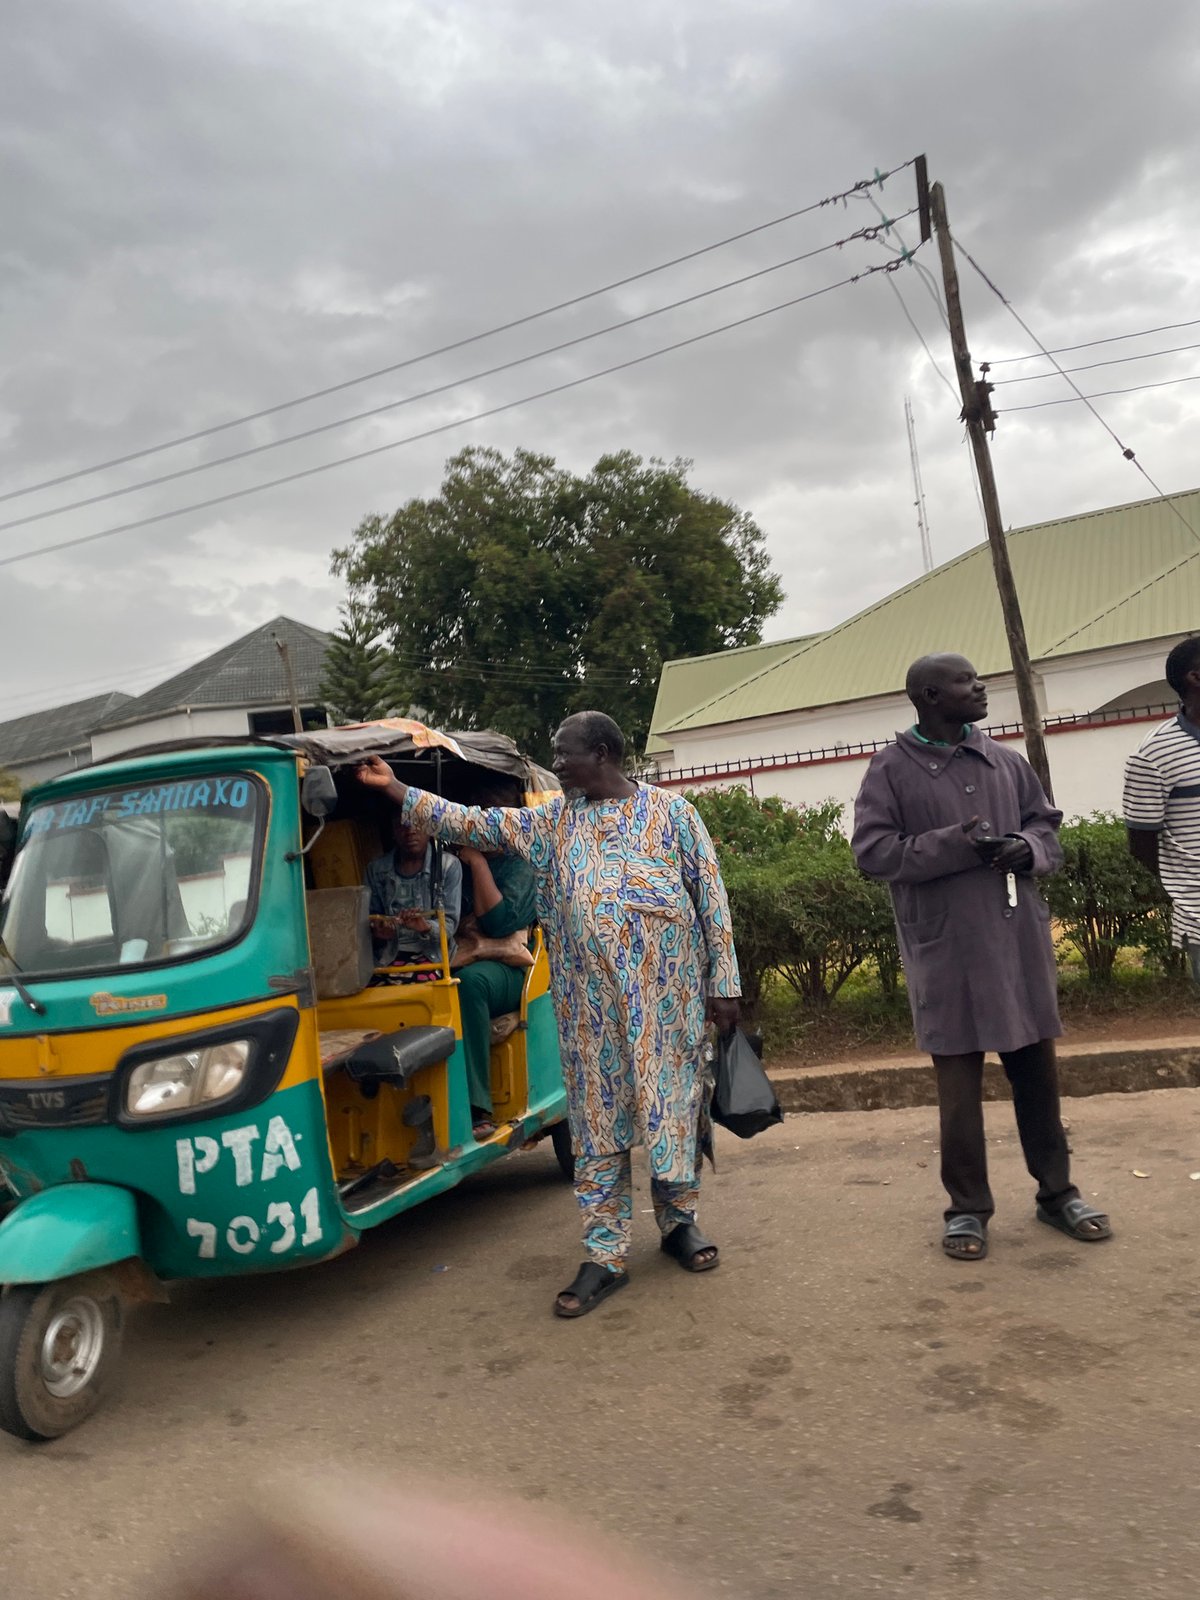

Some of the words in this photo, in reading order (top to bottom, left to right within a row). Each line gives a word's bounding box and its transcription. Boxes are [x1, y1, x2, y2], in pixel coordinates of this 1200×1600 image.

[117, 779, 248, 818] SAMMAKO
[27, 1091, 65, 1109] TVS
[176, 1115, 302, 1195] PTA
[187, 1187, 322, 1258] 7031
